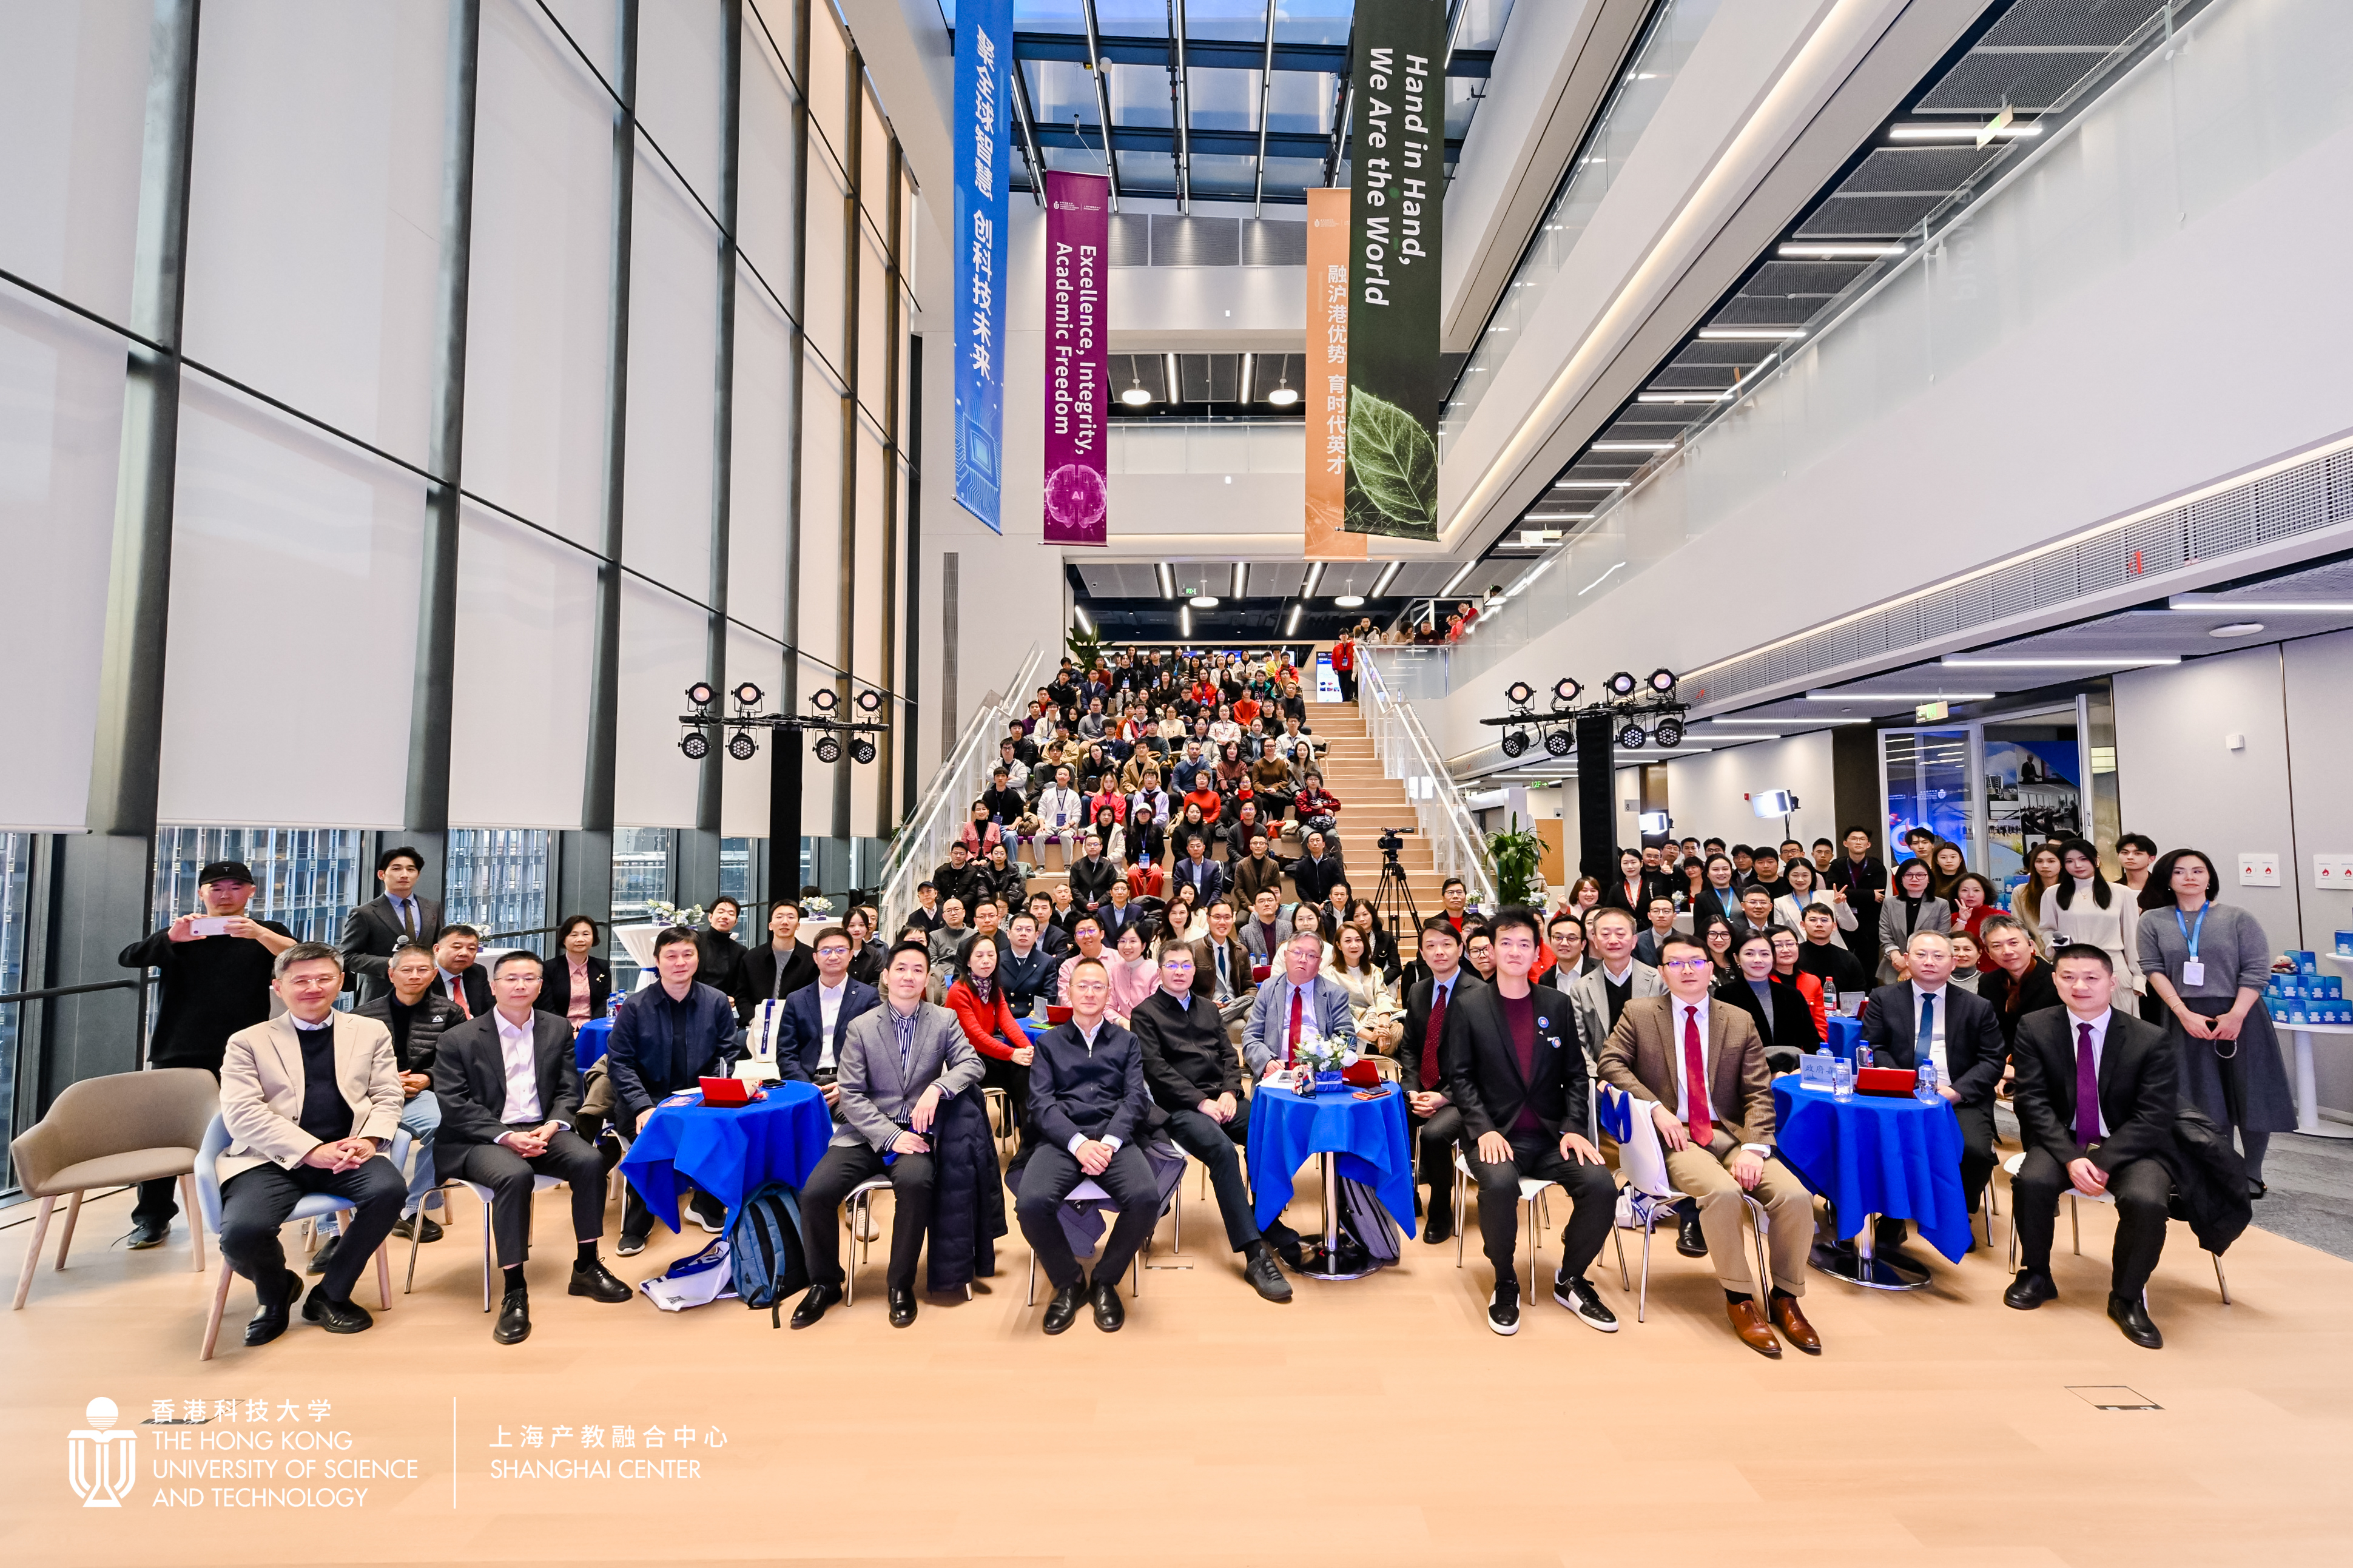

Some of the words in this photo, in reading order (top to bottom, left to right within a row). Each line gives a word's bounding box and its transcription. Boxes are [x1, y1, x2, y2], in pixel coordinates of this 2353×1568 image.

[974, 24, 995, 203] 聚全球智慧
[1370, 49, 1393, 90] We
[1405, 55, 1428, 133] Hand
[1368, 97, 1392, 148] Are
[1404, 141, 1428, 167] in
[1367, 158, 1392, 206] the
[1399, 178, 1426, 264] Hand,
[972, 209, 993, 380] 创科技未来
[1056, 242, 1073, 340] Academic
[1076, 245, 1097, 355] Excellence,
[1365, 217, 1389, 305] World
[1327, 264, 1347, 363] 融沪港优势
[1055, 346, 1072, 434] Freedom
[1076, 362, 1096, 455] Integrity,
[1327, 374, 1346, 474] 育时代英才
[1071, 491, 1084, 500] AI
